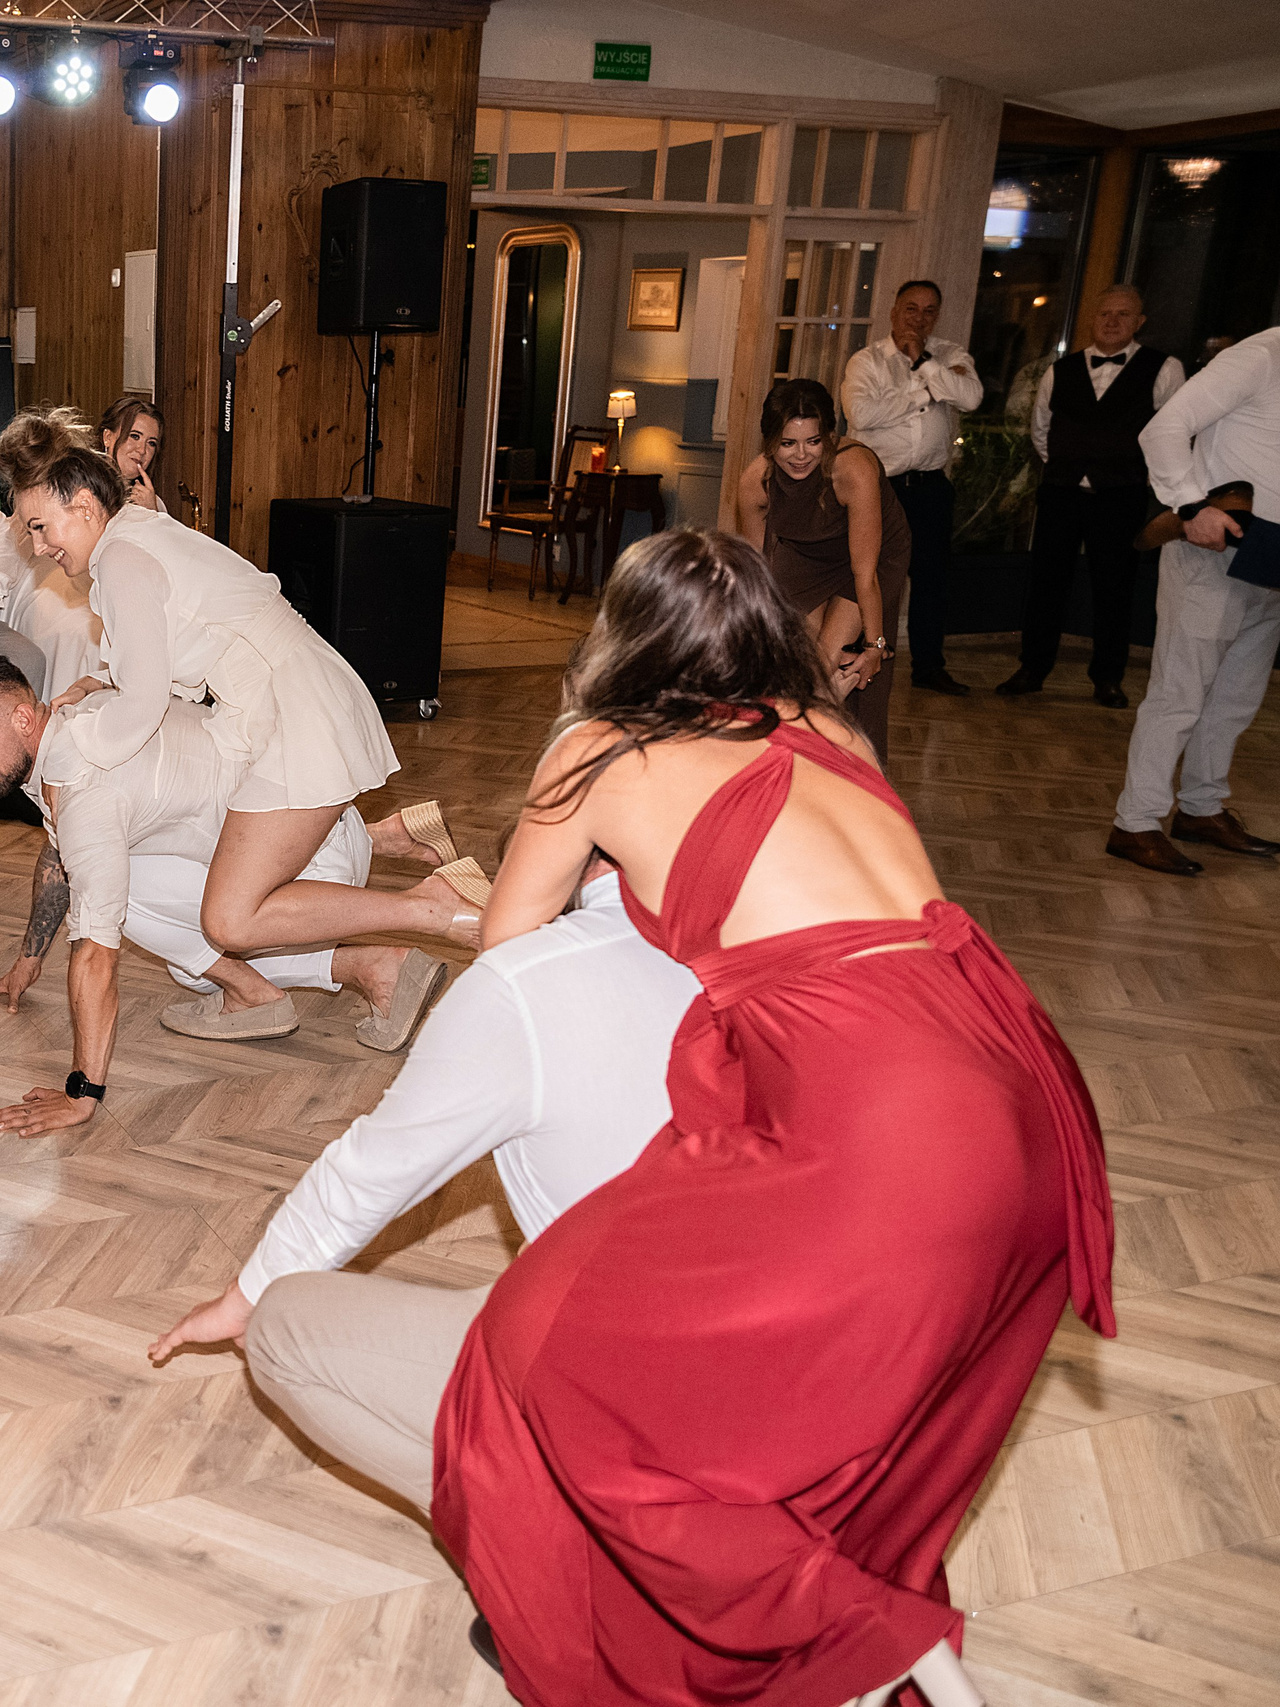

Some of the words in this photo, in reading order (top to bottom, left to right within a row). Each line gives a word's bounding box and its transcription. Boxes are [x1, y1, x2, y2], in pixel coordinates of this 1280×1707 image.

[596, 49, 649, 65] WYJŚCIE
[225, 380, 233, 400] Studio
[224, 400, 232, 432] GOLIATH
